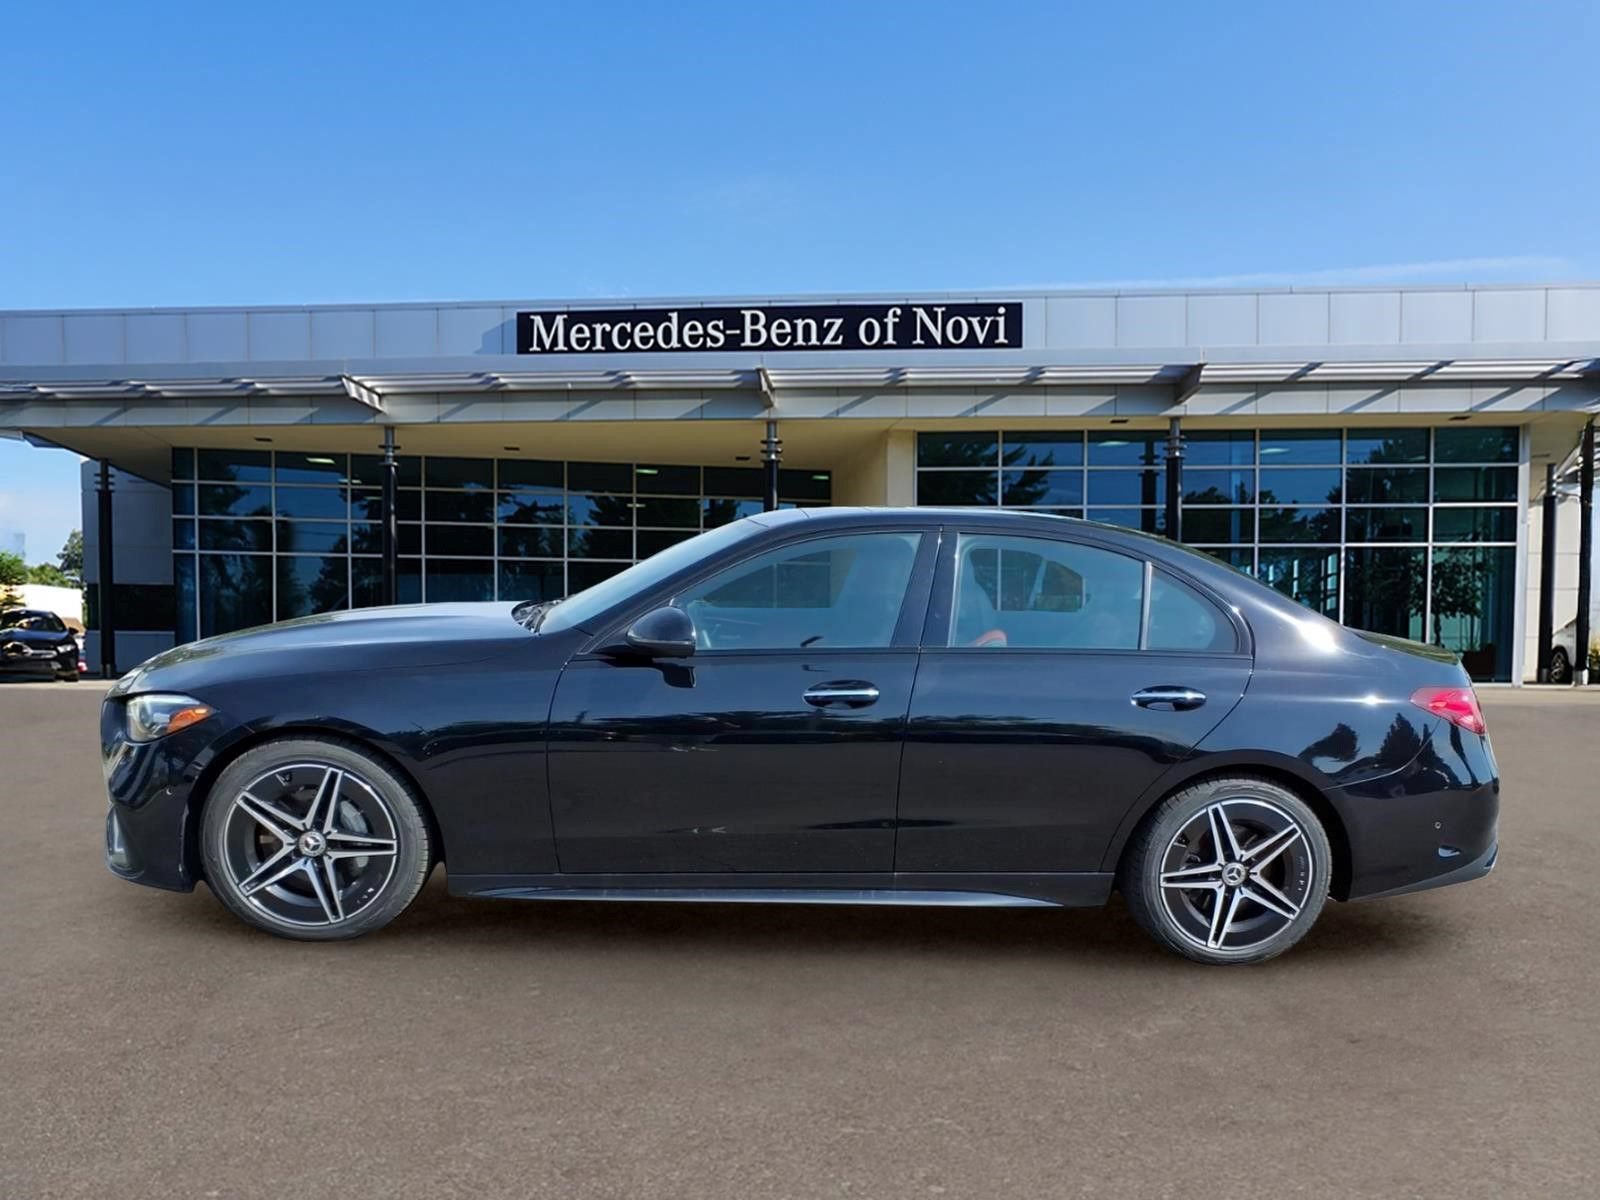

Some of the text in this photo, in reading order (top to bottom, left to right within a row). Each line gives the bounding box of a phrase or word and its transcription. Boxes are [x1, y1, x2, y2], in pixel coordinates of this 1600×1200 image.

[529, 306, 1009, 352] Mercedes-Benz of Novi
